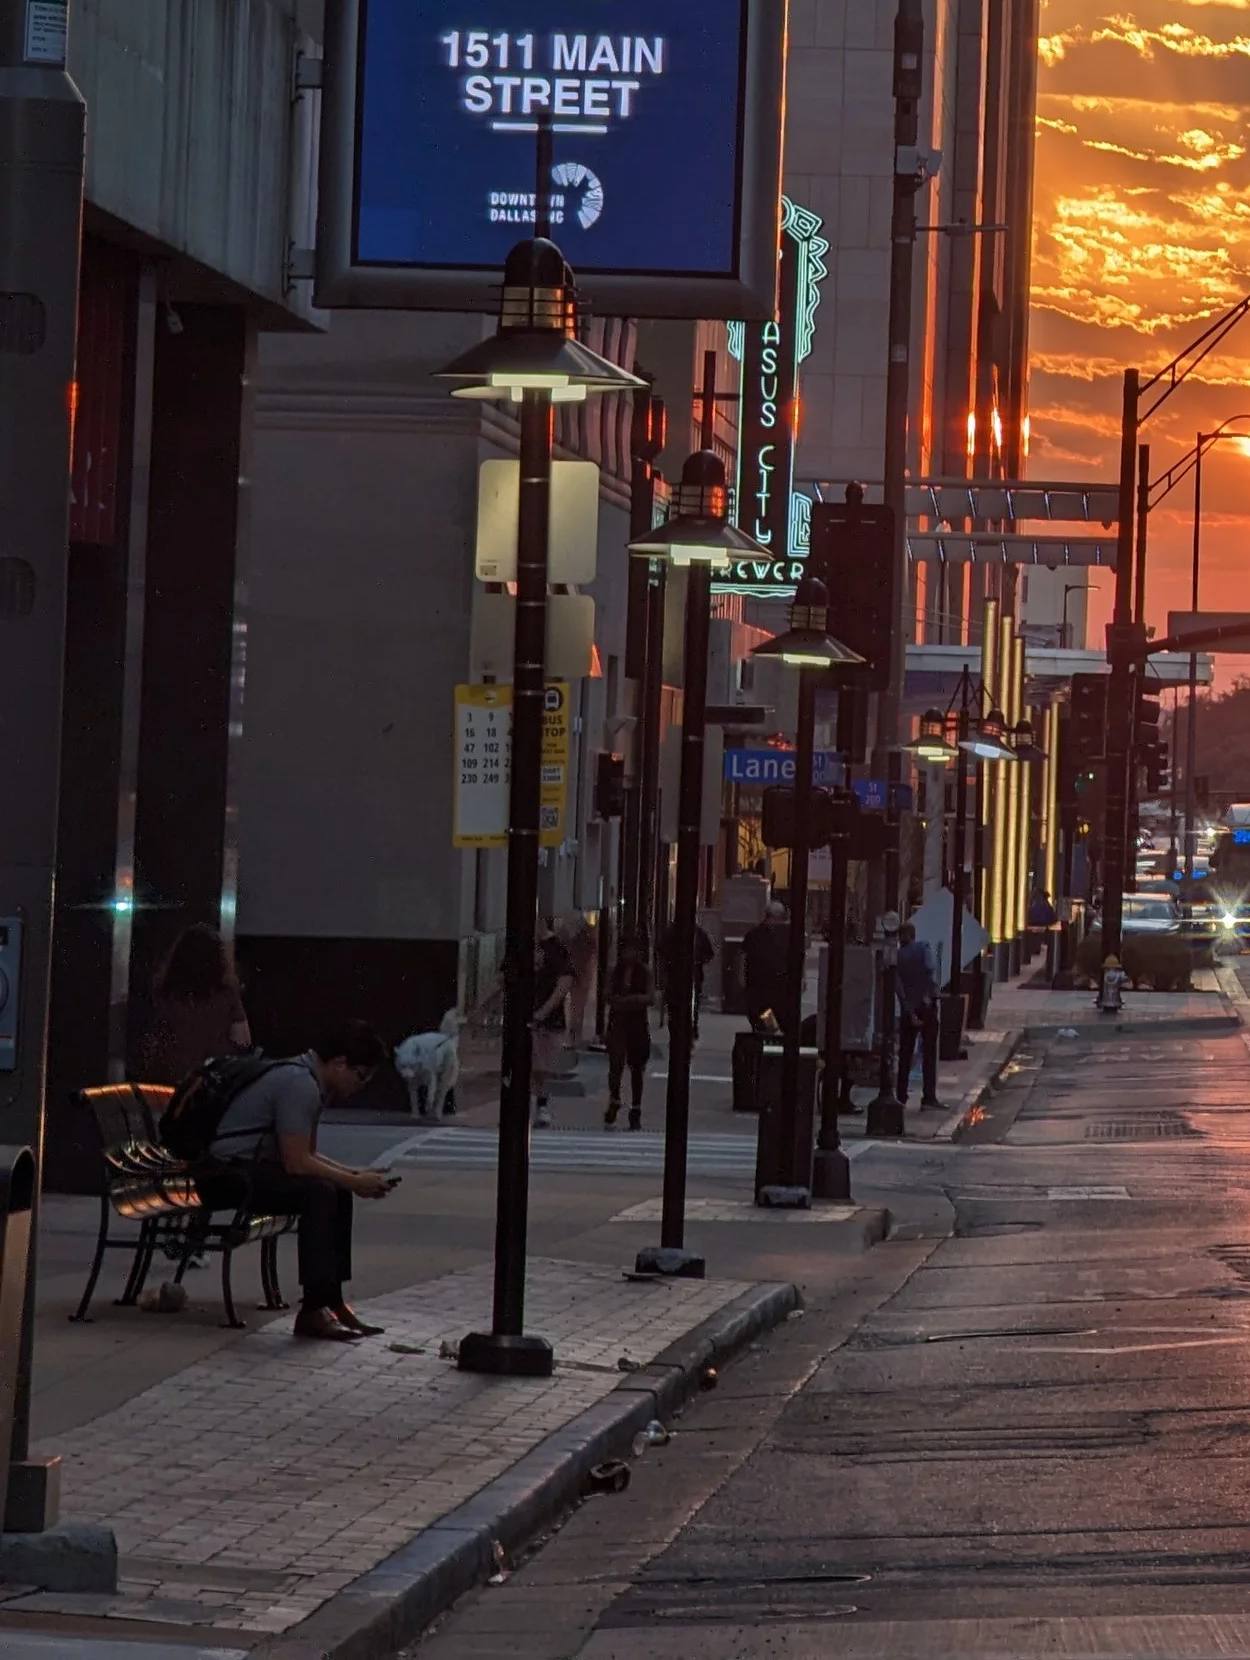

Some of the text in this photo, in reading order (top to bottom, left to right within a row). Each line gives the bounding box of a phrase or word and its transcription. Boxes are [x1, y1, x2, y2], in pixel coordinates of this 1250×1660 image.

[442, 32, 664, 74] 1511 MAIN
[464, 76, 641, 117] STREET
[490, 192, 565, 207] DOWNTN
[490, 209, 537, 223] DALLAS
[755, 321, 780, 544] ASUS CITY
[710, 560, 805, 582] REWER
[488, 712, 494, 722] 9
[541, 715, 563, 724] BUS
[464, 728, 497, 738] 16 18
[464, 743, 500, 753] 47 102
[462, 759, 499, 768] 109 214
[731, 753, 796, 779] Lane
[483, 774, 500, 784] 249
